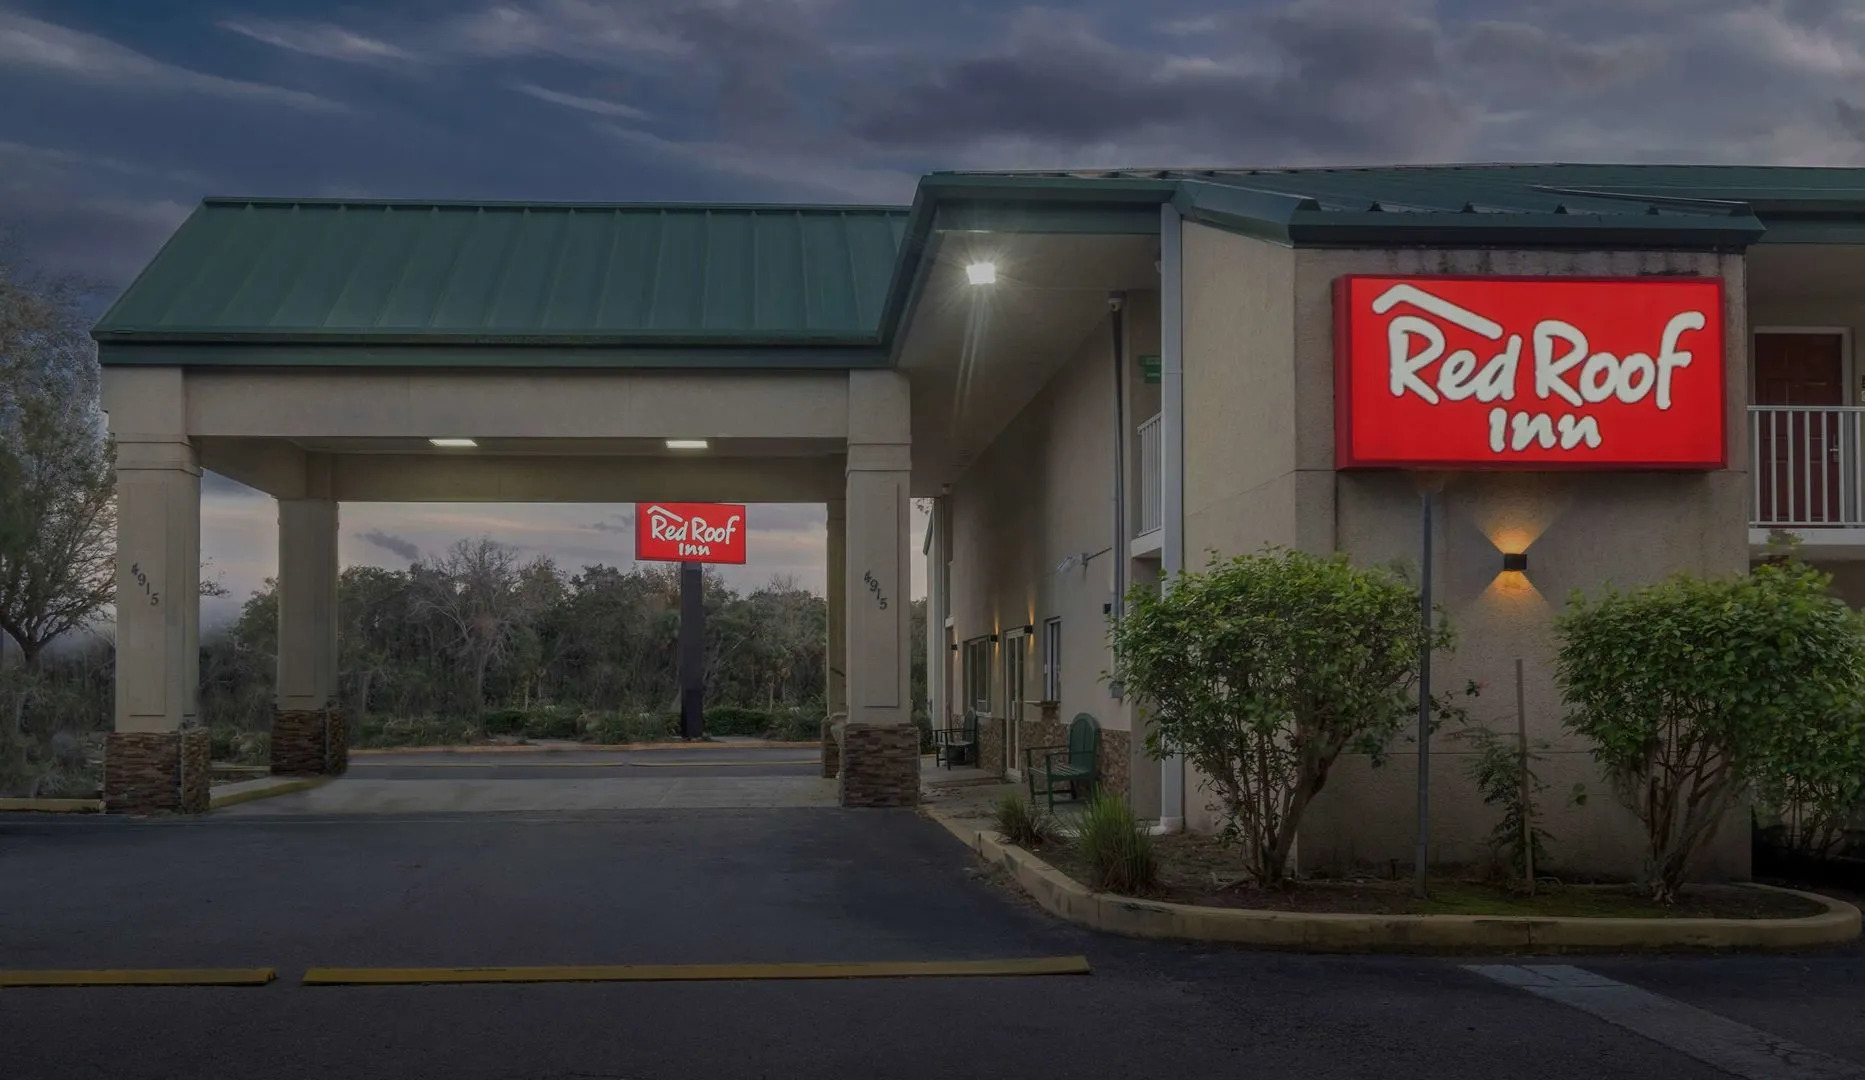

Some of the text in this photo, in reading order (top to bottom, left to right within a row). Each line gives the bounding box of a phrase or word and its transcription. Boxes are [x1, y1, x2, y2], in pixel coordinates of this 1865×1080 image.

[1387, 310, 1706, 411] Red Roof
[1488, 406, 1602, 453] Inn
[651, 514, 740, 545] Red Roof
[678, 542, 711, 556] Inn
[130, 562, 160, 607] 4915
[863, 569, 889, 611] 4915
